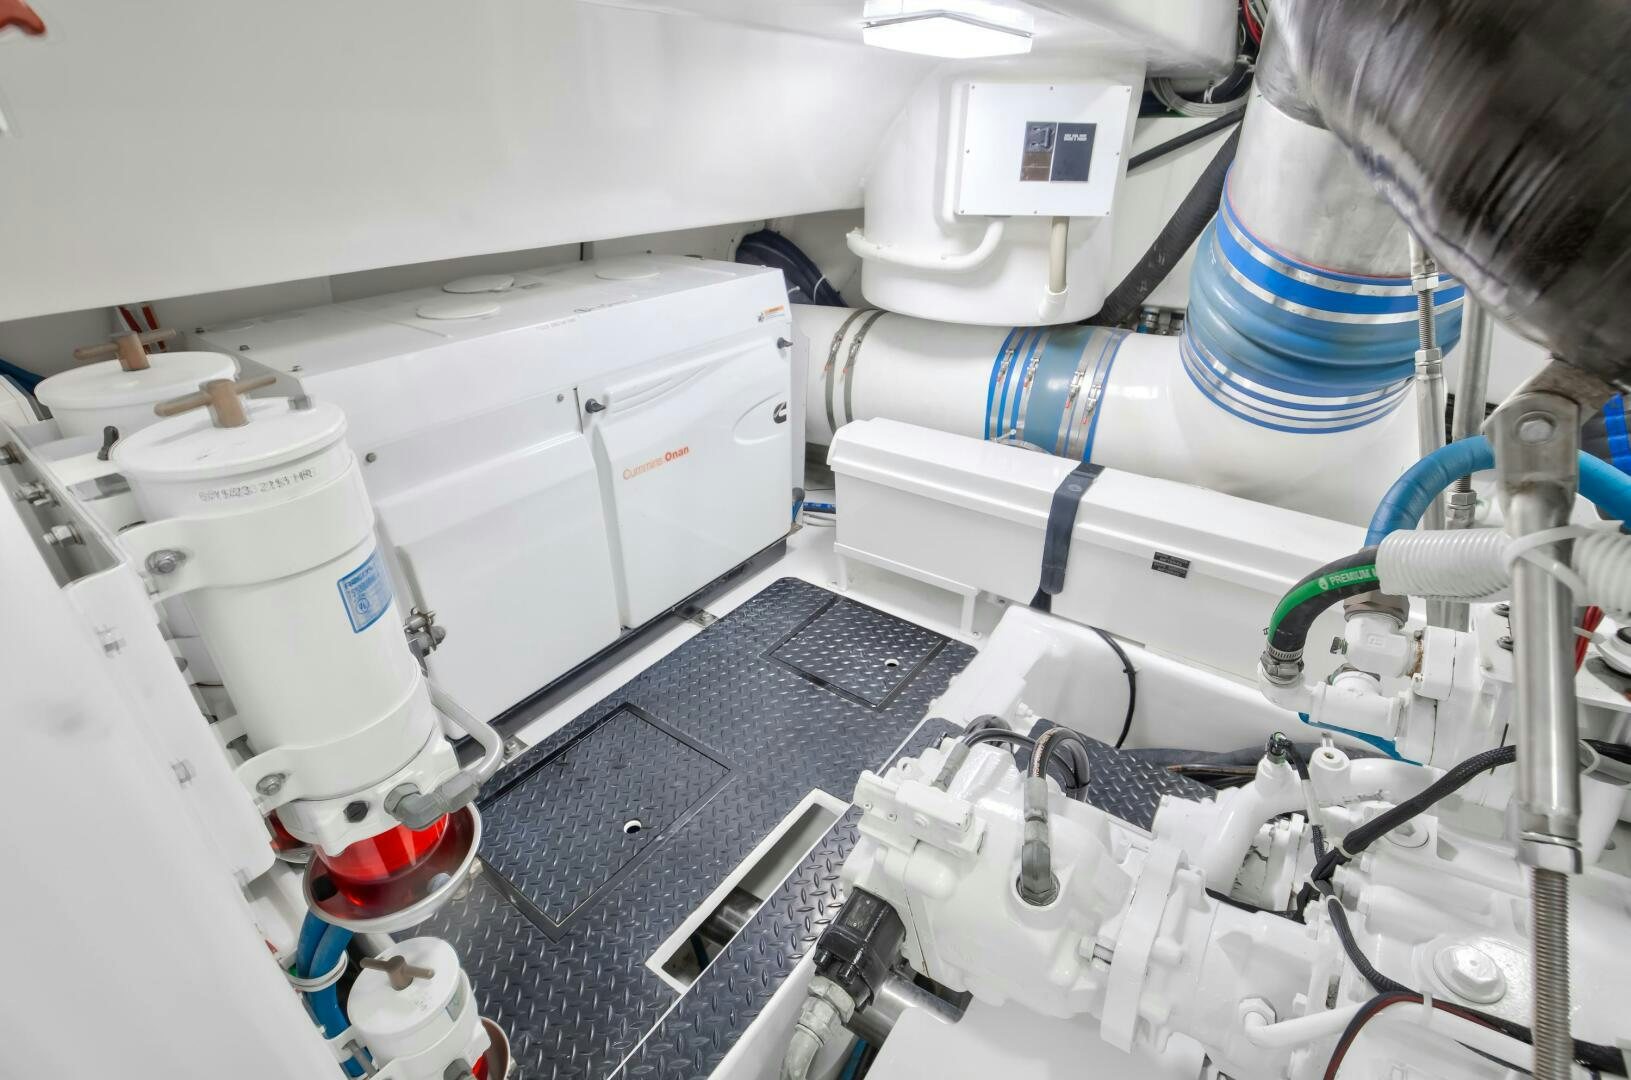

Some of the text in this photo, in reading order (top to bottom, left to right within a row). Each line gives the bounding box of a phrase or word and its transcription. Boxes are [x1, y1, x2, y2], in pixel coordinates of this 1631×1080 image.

[623, 446, 690, 480] Cummins Onan
[1329, 568, 1371, 586] PREMIUM
